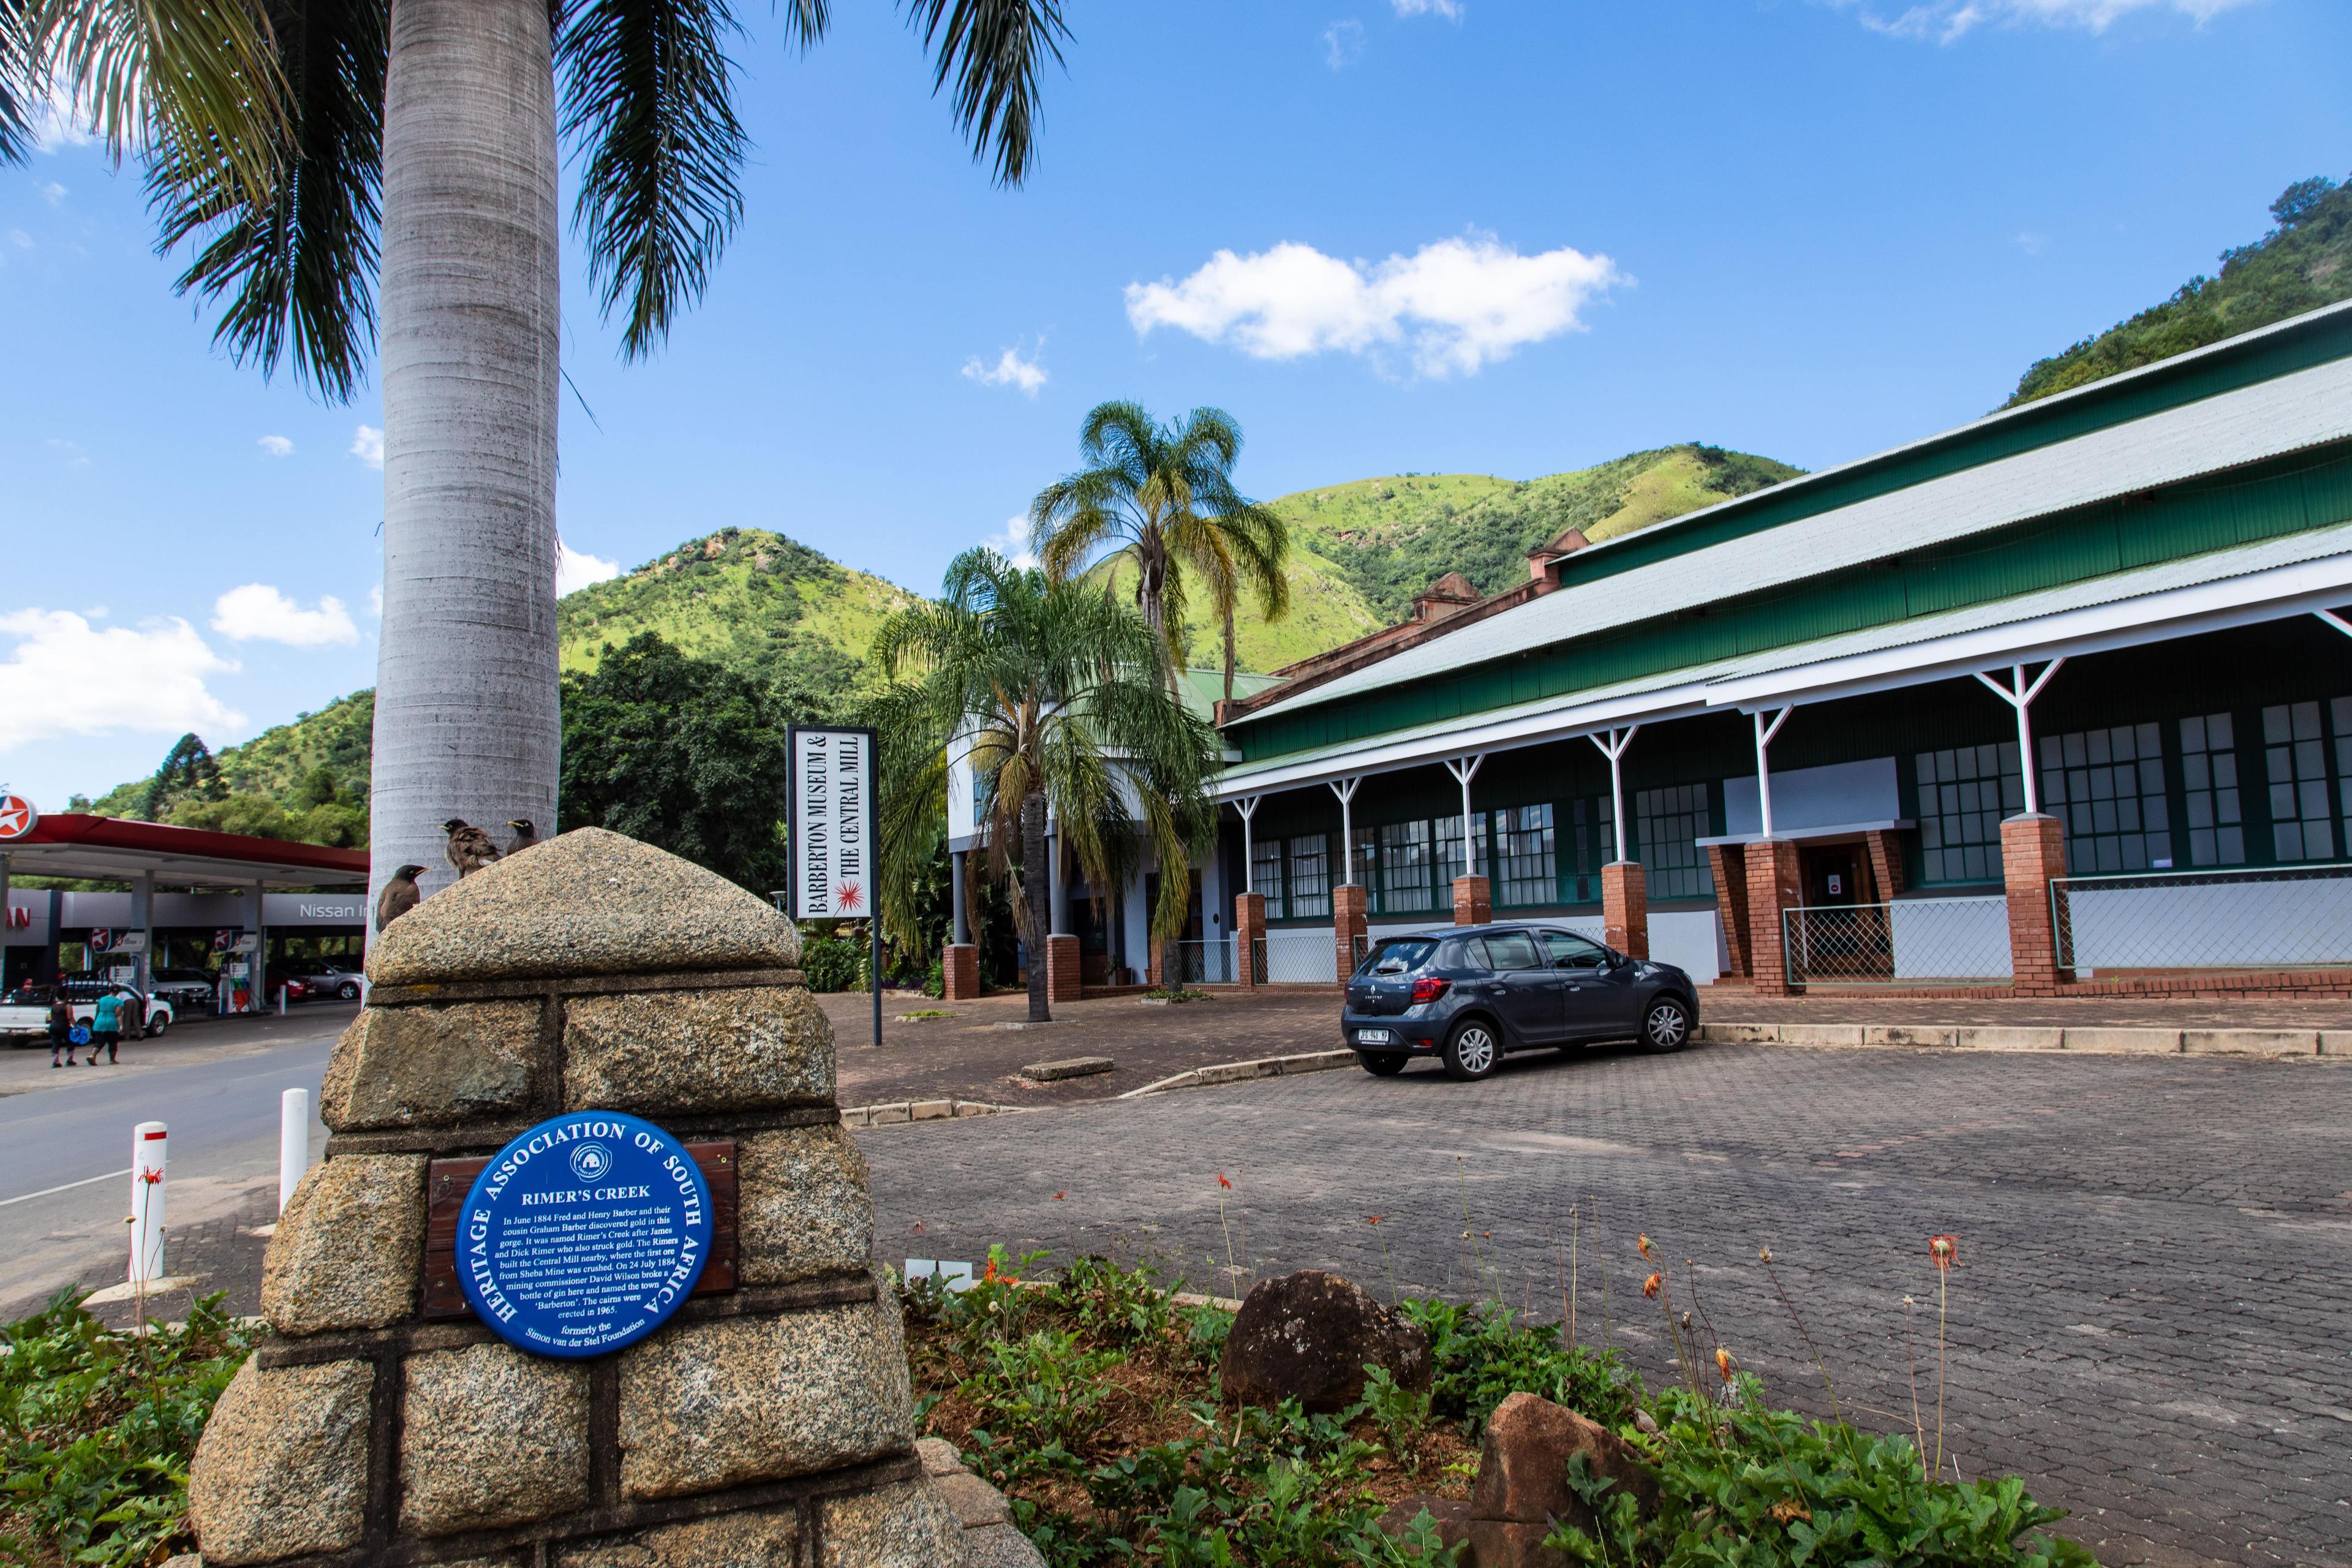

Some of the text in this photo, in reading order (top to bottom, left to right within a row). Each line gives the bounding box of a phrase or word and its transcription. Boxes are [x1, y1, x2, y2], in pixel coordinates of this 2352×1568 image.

[840, 737, 859, 878] THE CENTRAL MILL
[807, 735, 827, 913] BARBERTON MUSEUM &
[300, 904, 354, 918] Nissan
[1381, 1031, 1387, 1040] MP
[521, 1185, 651, 1206] RIMER'S CREEK
[470, 1121, 701, 1324] HERITAGE ASSOCIATION OF SOUTH AFRICA
[554, 1213, 571, 1221] Fred
[612, 1208, 637, 1217] Barber
[639, 1207, 652, 1215] and
[503, 1227, 527, 1236] cousin
[562, 1223, 587, 1232] Barber
[589, 1219, 628, 1229] discovered
[630, 1218, 646, 1228] gold
[657, 1216, 670, 1224] this
[495, 1250, 509, 1259] and
[511, 1248, 529, 1257] Dick
[531, 1247, 555, 1256] Rimer
[557, 1245, 573, 1254] who
[592, 1242, 614, 1251] struck
[616, 1240, 635, 1250] gold.
[652, 1237, 678, 1246] Rimers
[500, 1240, 523, 1249] gorge.
[550, 1234, 575, 1243] named
[577, 1232, 606, 1241] Rimer's
[608, 1229, 630, 1238] Creek
[632, 1229, 649, 1237] after
[500, 1260, 518, 1269] built
[533, 1257, 560, 1266] Central
[563, 1255, 579, 1264] Mill
[581, 1253, 608, 1262] nearby,
[610, 1251, 632, 1260] where
[647, 1248, 662, 1257] first
[519, 1269, 543, 1278] Sheba
[545, 1267, 565, 1276] Mine
[583, 1263, 614, 1273] crushed.
[641, 1259, 656, 1268] July
[658, 1257, 676, 1267] 1884
[506, 1281, 533, 1291] mining
[535, 1277, 587, 1287] commissioner
[589, 1274, 612, 1283] David
[614, 1272, 639, 1281] Wilson
[641, 1270, 662, 1278] broke
[519, 1291, 541, 1300] bottle
[543, 1289, 553, 1298] of
[554, 1289, 566, 1299] gin
[567, 1287, 584, 1296] here
[586, 1286, 600, 1294] and
[601, 1283, 626, 1293] named
[599, 1295, 621, 1304] cairns
[558, 1308, 585, 1319] erected
[597, 1306, 617, 1316] 1965.
[525, 1319, 645, 1347] Simon van der Stel Foundation
[561, 1322, 611, 1335] formerly the
